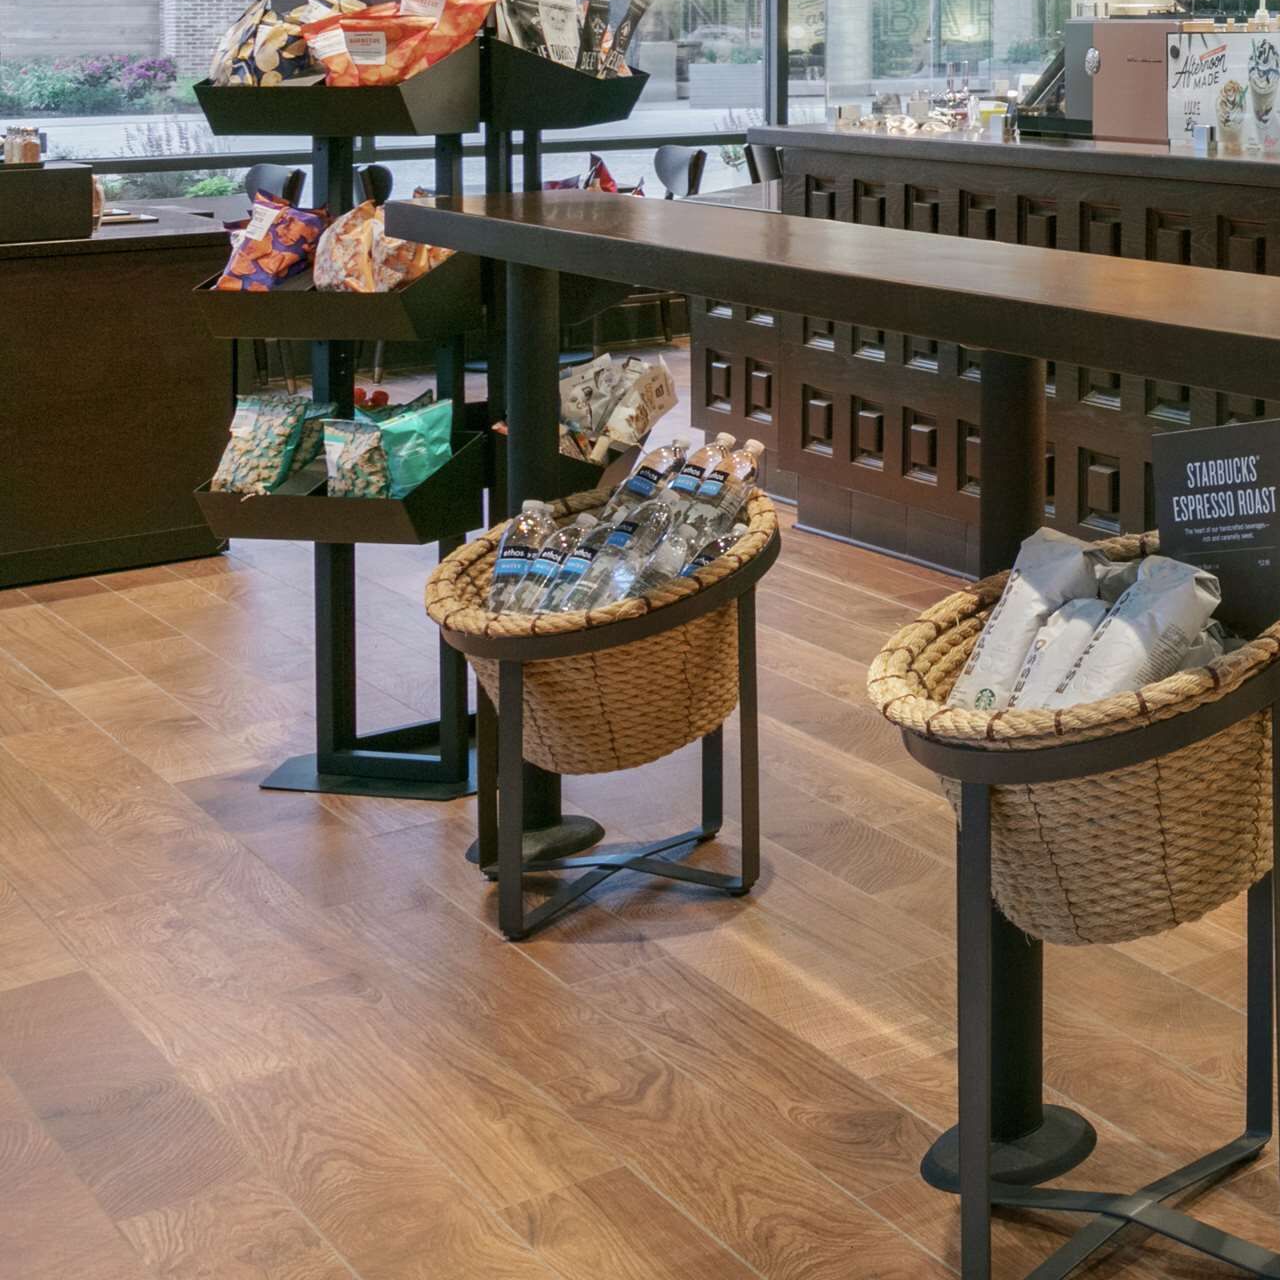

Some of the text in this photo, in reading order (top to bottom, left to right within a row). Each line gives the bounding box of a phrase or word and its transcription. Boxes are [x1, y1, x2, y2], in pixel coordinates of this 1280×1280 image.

[1172, 51, 1228, 89] Afternoon
[1194, 73, 1219, 89] MADE
[1172, 486, 1276, 522] ESPRESSO ROAST
[503, 549, 525, 558] ethos
